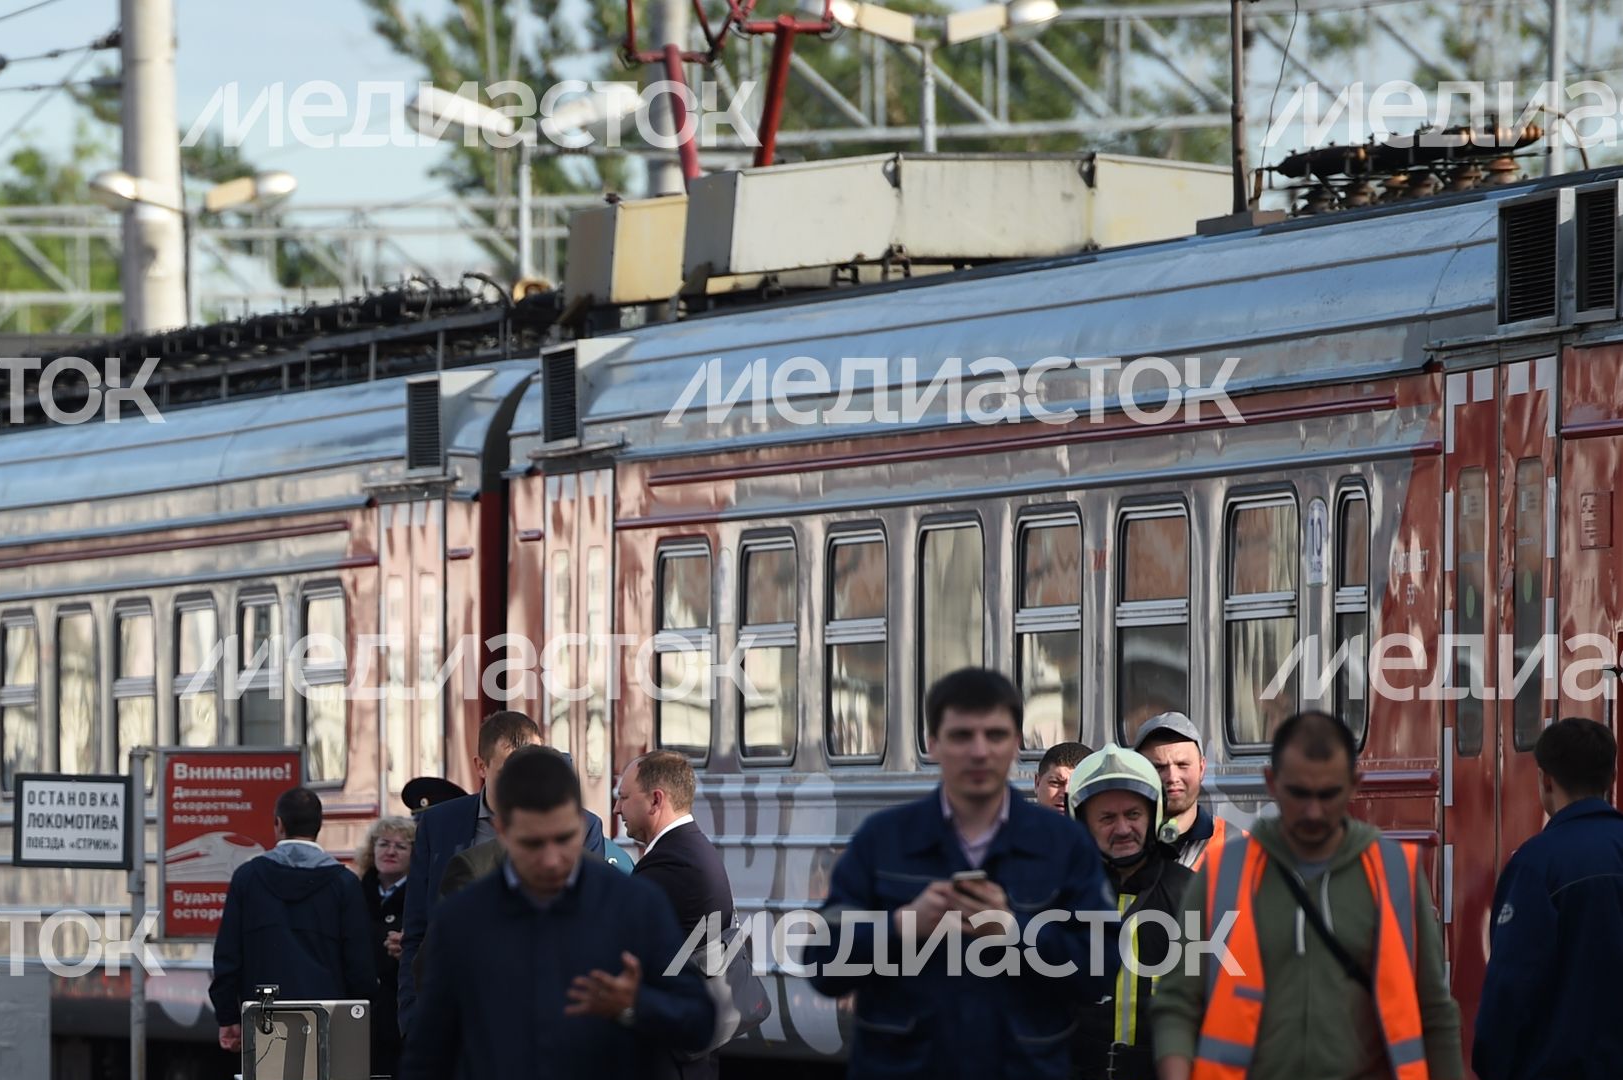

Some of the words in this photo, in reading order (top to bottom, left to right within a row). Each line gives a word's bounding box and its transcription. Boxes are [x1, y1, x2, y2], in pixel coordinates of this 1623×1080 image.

[172, 762, 292, 780] Внимание!
[27, 790, 120, 807] ОСТАНОВКА
[172, 785, 243, 799] Движение
[172, 801, 253, 813] скоростных
[26, 812, 119, 831] ЛОКОМОТИВА
[172, 814, 229, 826] поездов
[172, 889, 227, 906] Будьте
